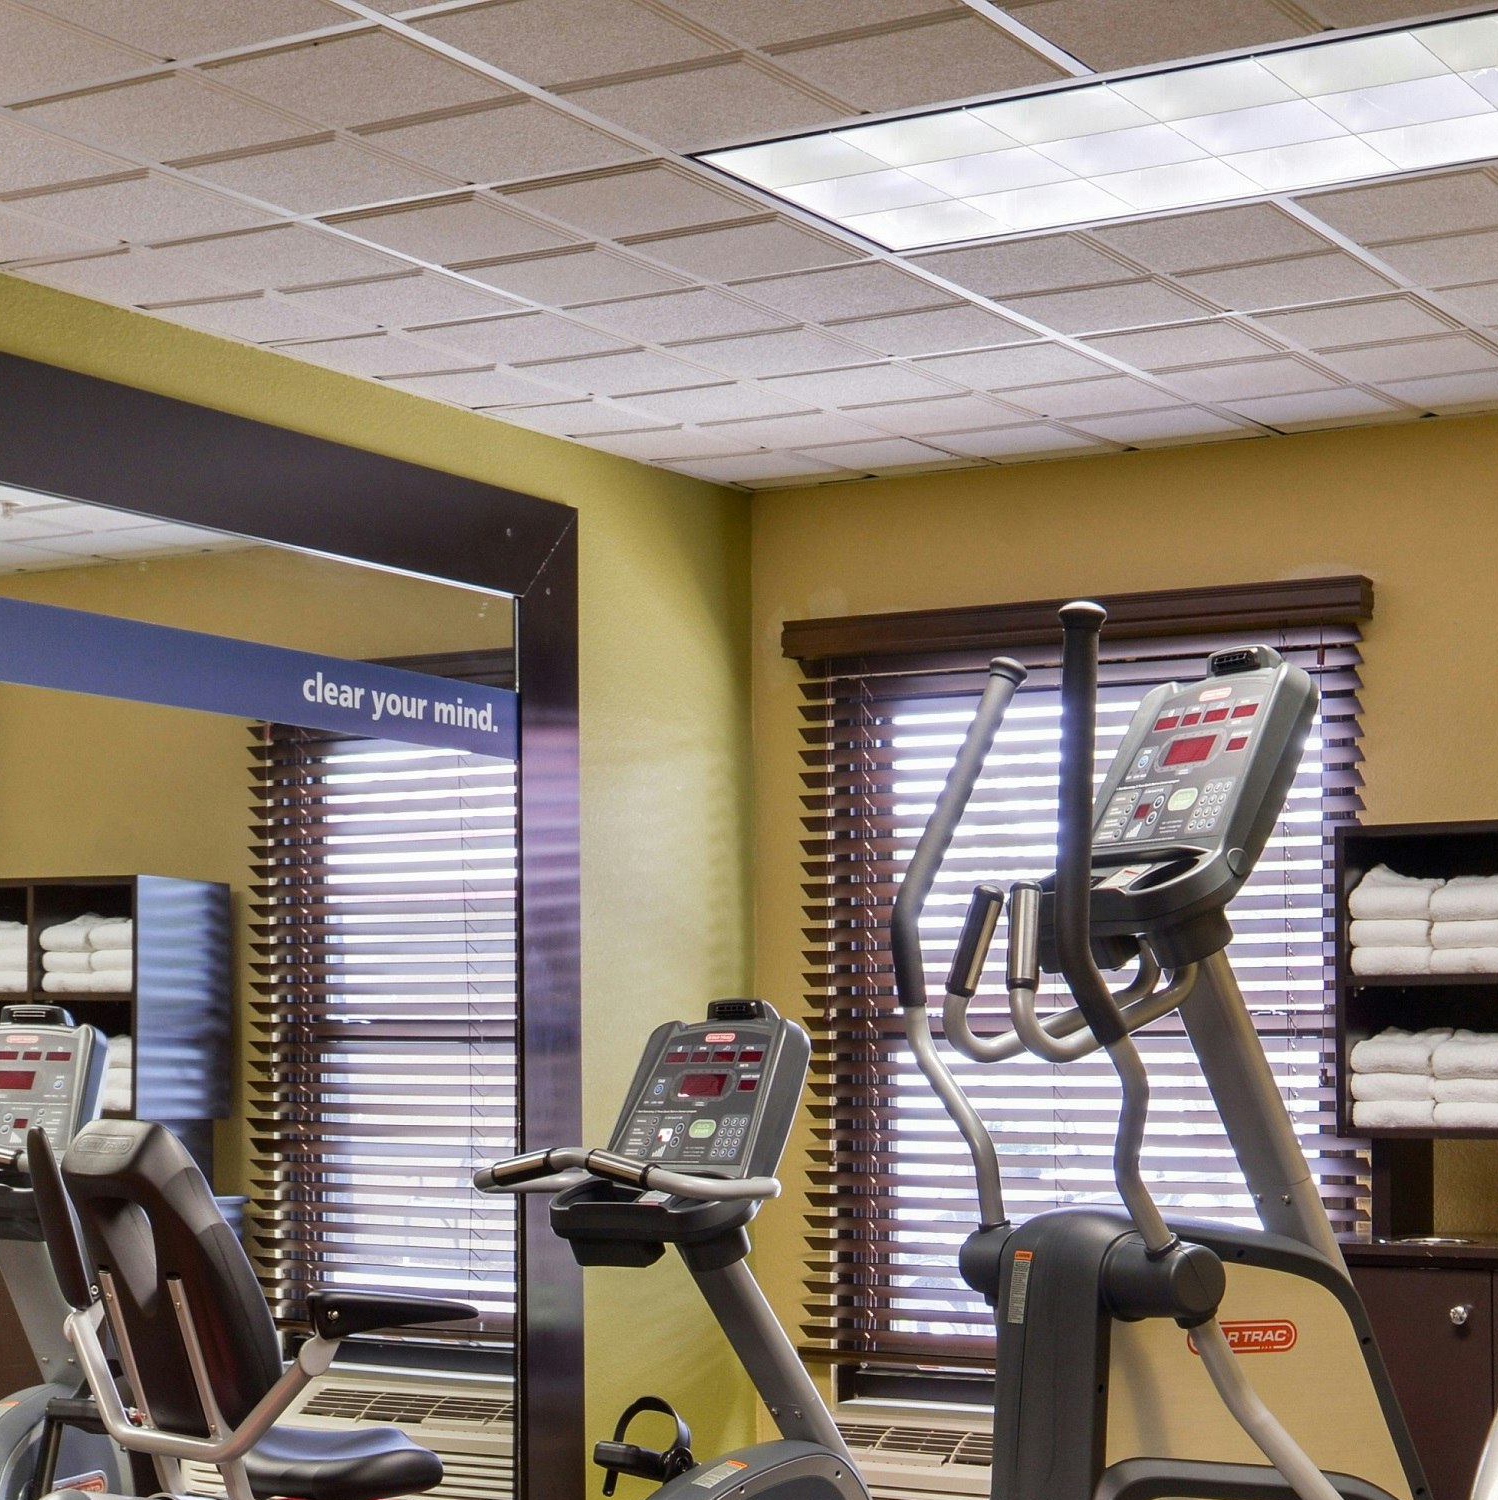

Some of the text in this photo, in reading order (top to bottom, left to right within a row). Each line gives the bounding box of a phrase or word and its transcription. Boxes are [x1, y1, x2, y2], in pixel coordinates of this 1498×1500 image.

[302, 672, 498, 733] clear your mind.
[1242, 1329, 1287, 1342] TRAC
